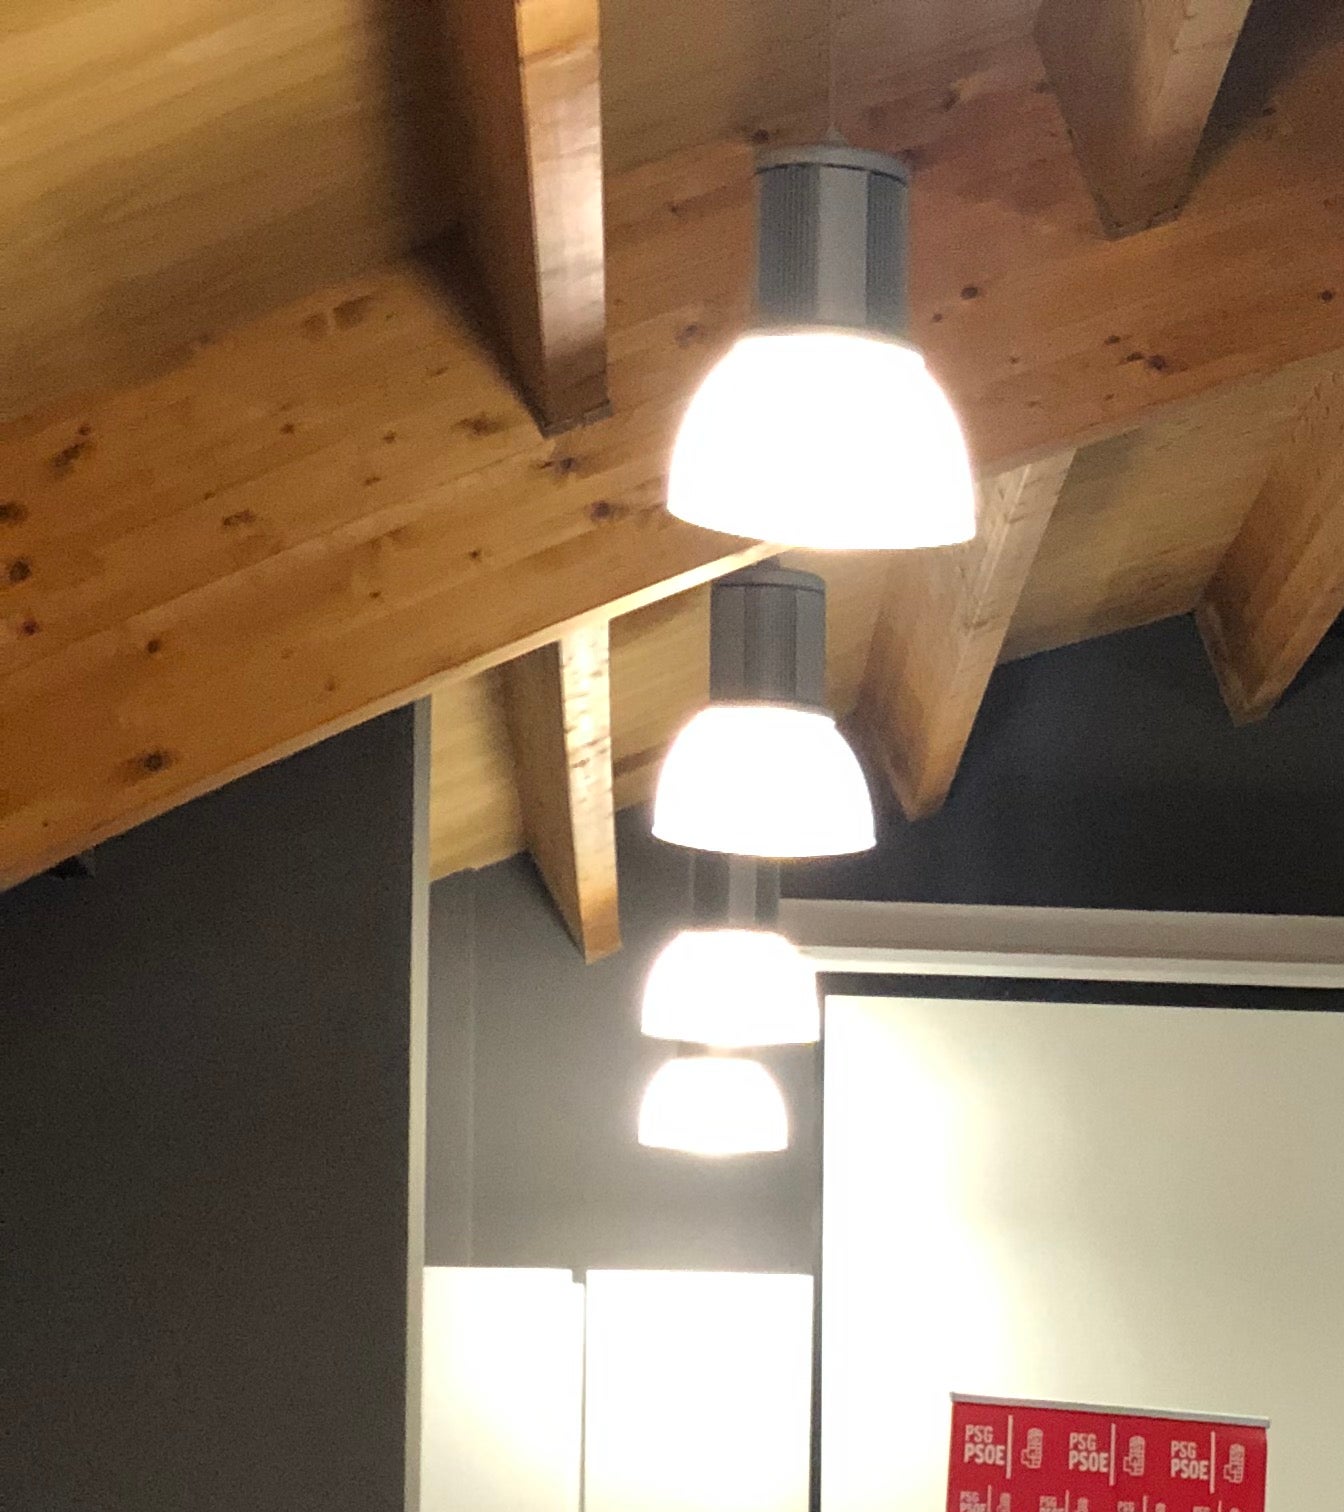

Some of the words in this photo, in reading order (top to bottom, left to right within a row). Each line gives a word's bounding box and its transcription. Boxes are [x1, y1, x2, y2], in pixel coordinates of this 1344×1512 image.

[965, 1424, 993, 1445] PSG
[1069, 1432, 1097, 1450] PSG
[963, 1444, 1005, 1465] PSOE
[1171, 1441, 1197, 1458] PSG
[1068, 1451, 1108, 1472] PSOE
[1171, 1458, 1209, 1480] PSOE
